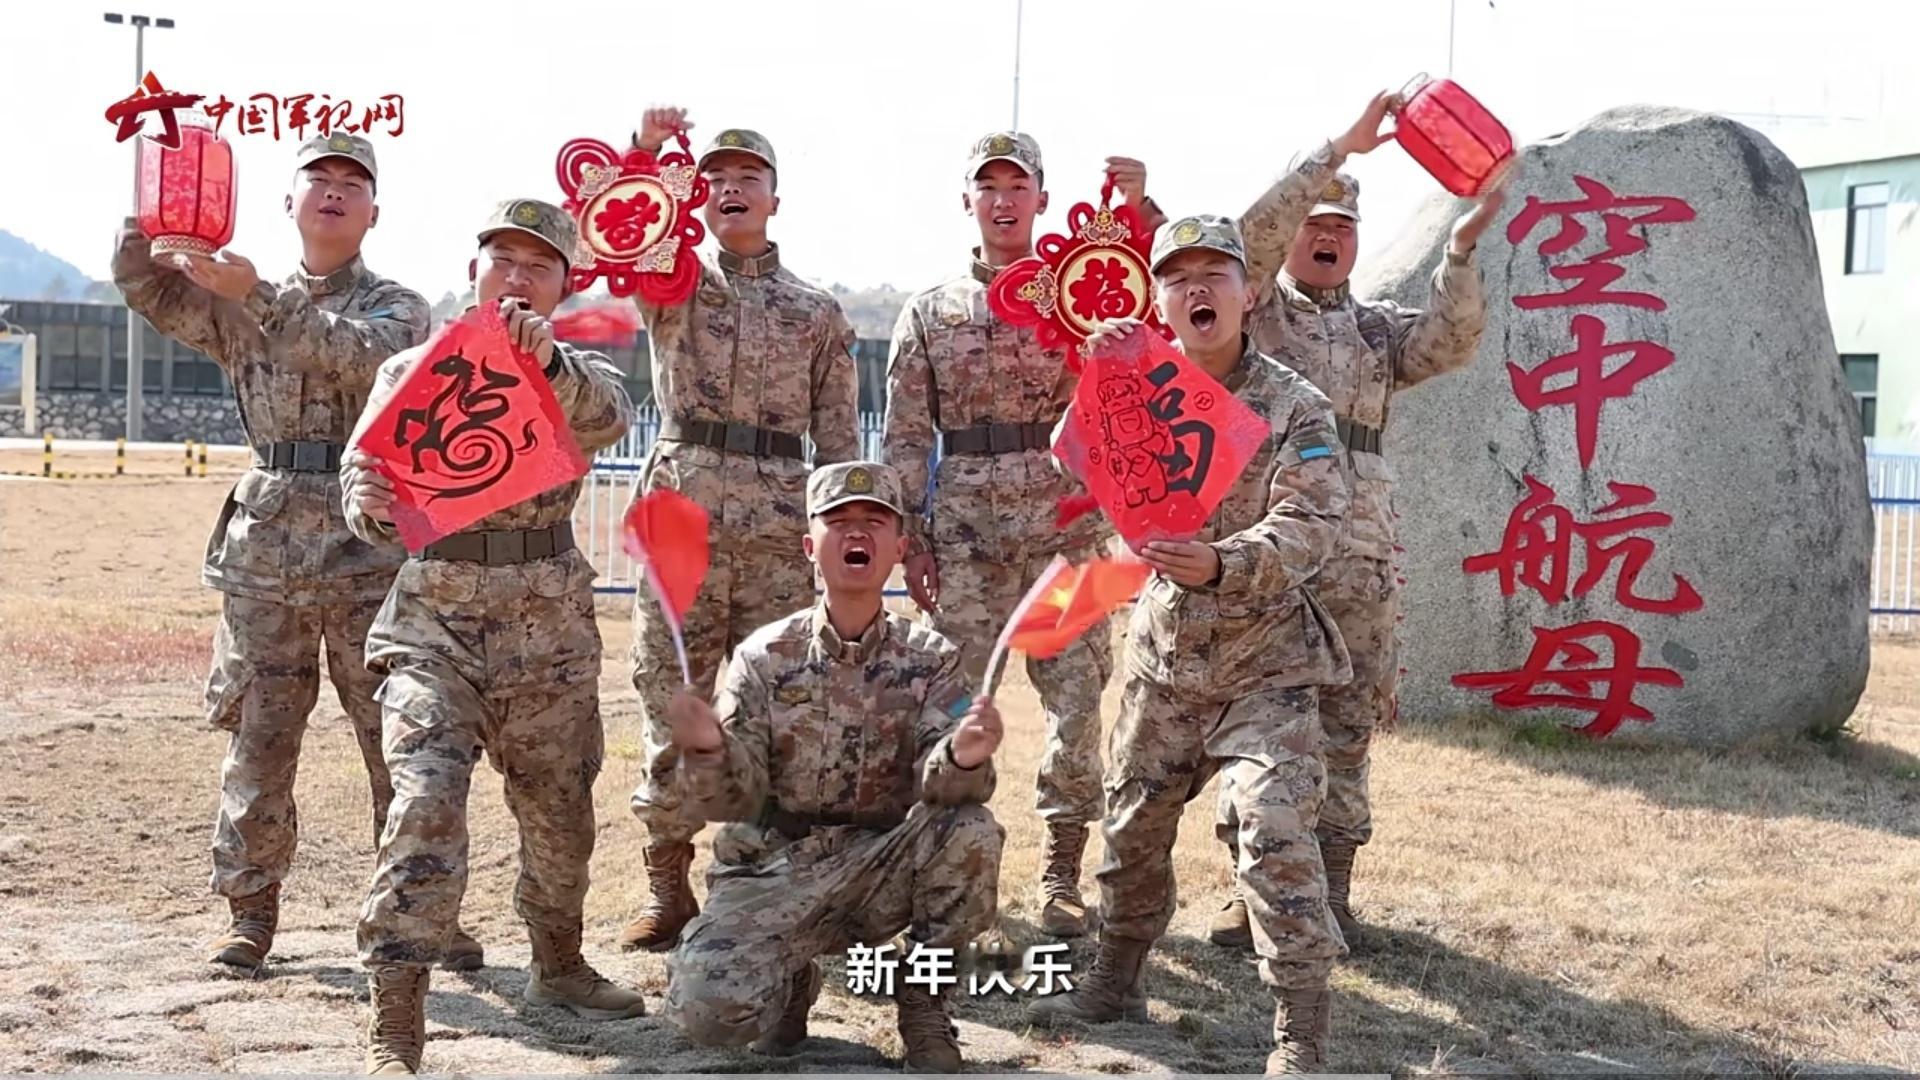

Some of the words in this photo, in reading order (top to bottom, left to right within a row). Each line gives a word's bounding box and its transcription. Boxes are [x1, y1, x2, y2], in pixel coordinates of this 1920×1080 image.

[1068, 257, 1137, 322] 福
[1452, 174, 1704, 737] 空中航母
